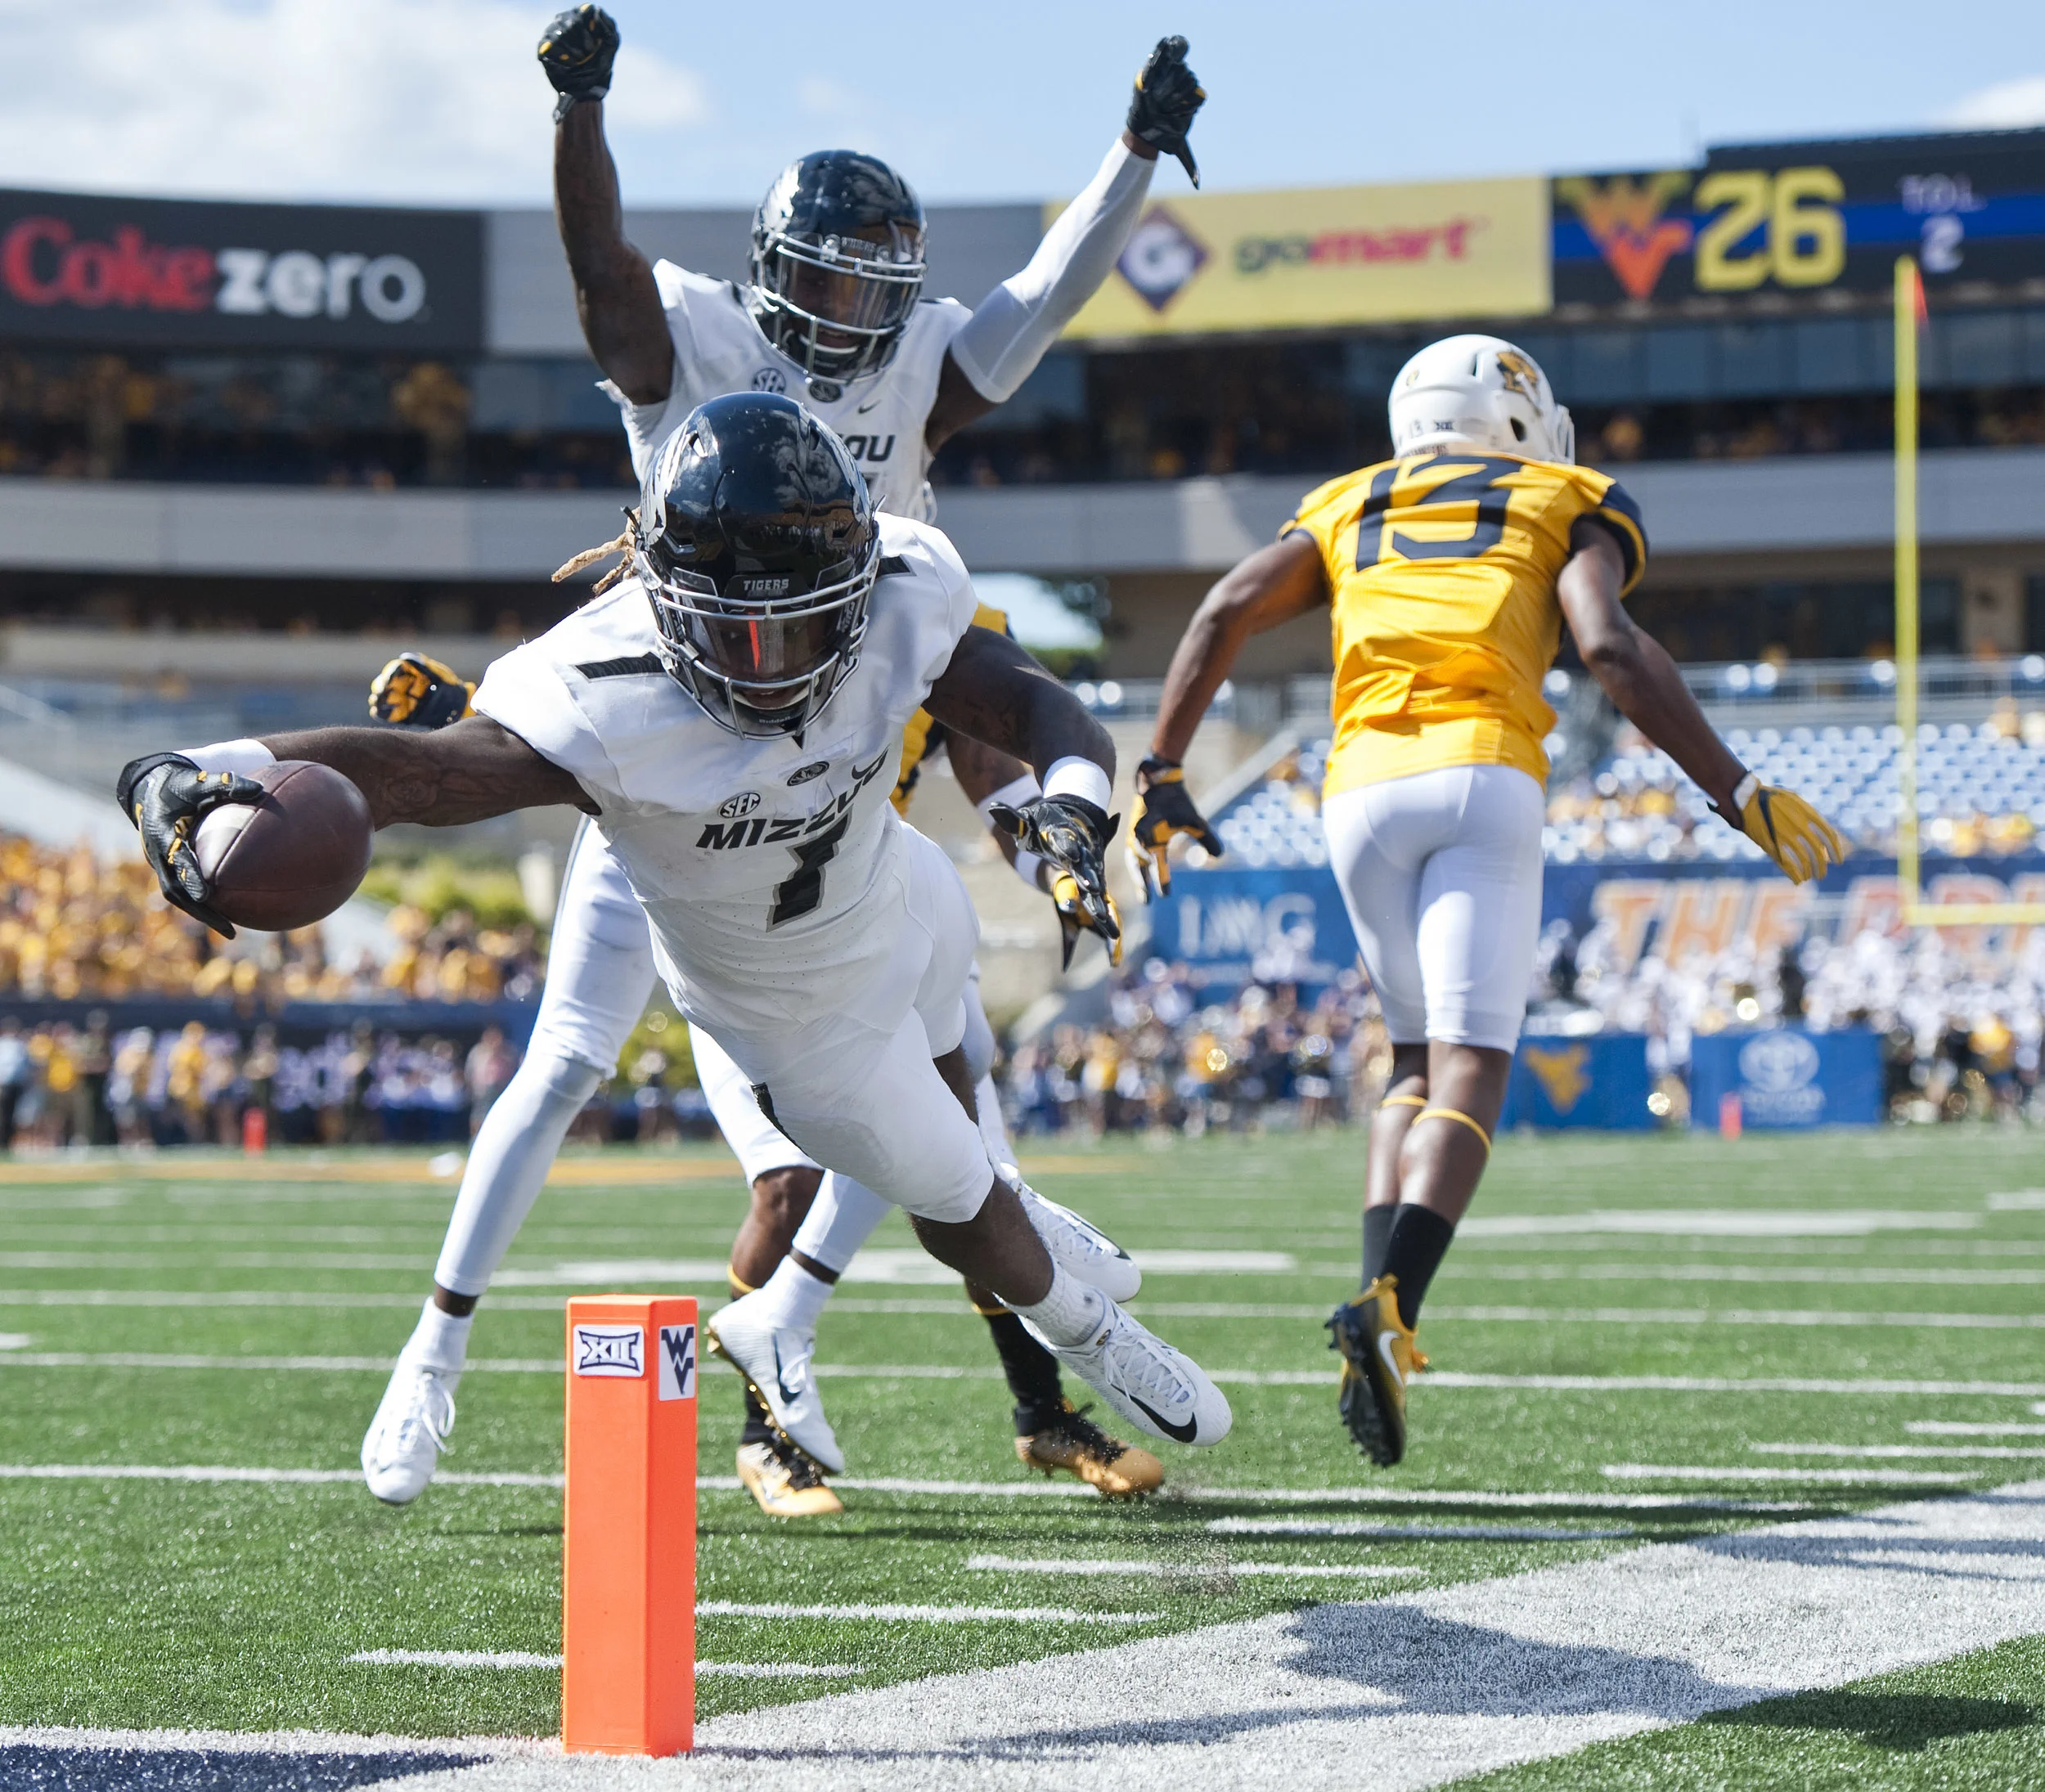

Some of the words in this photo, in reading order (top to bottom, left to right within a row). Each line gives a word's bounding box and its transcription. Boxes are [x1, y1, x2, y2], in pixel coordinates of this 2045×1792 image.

[1694, 166, 1845, 291] 26
[1921, 215, 1964, 273] 2
[3, 217, 214, 309] Coke
[216, 248, 426, 322] zero
[1355, 455, 1523, 573] 13
[743, 578, 789, 591] TIGERS
[720, 792, 761, 818] SEC
